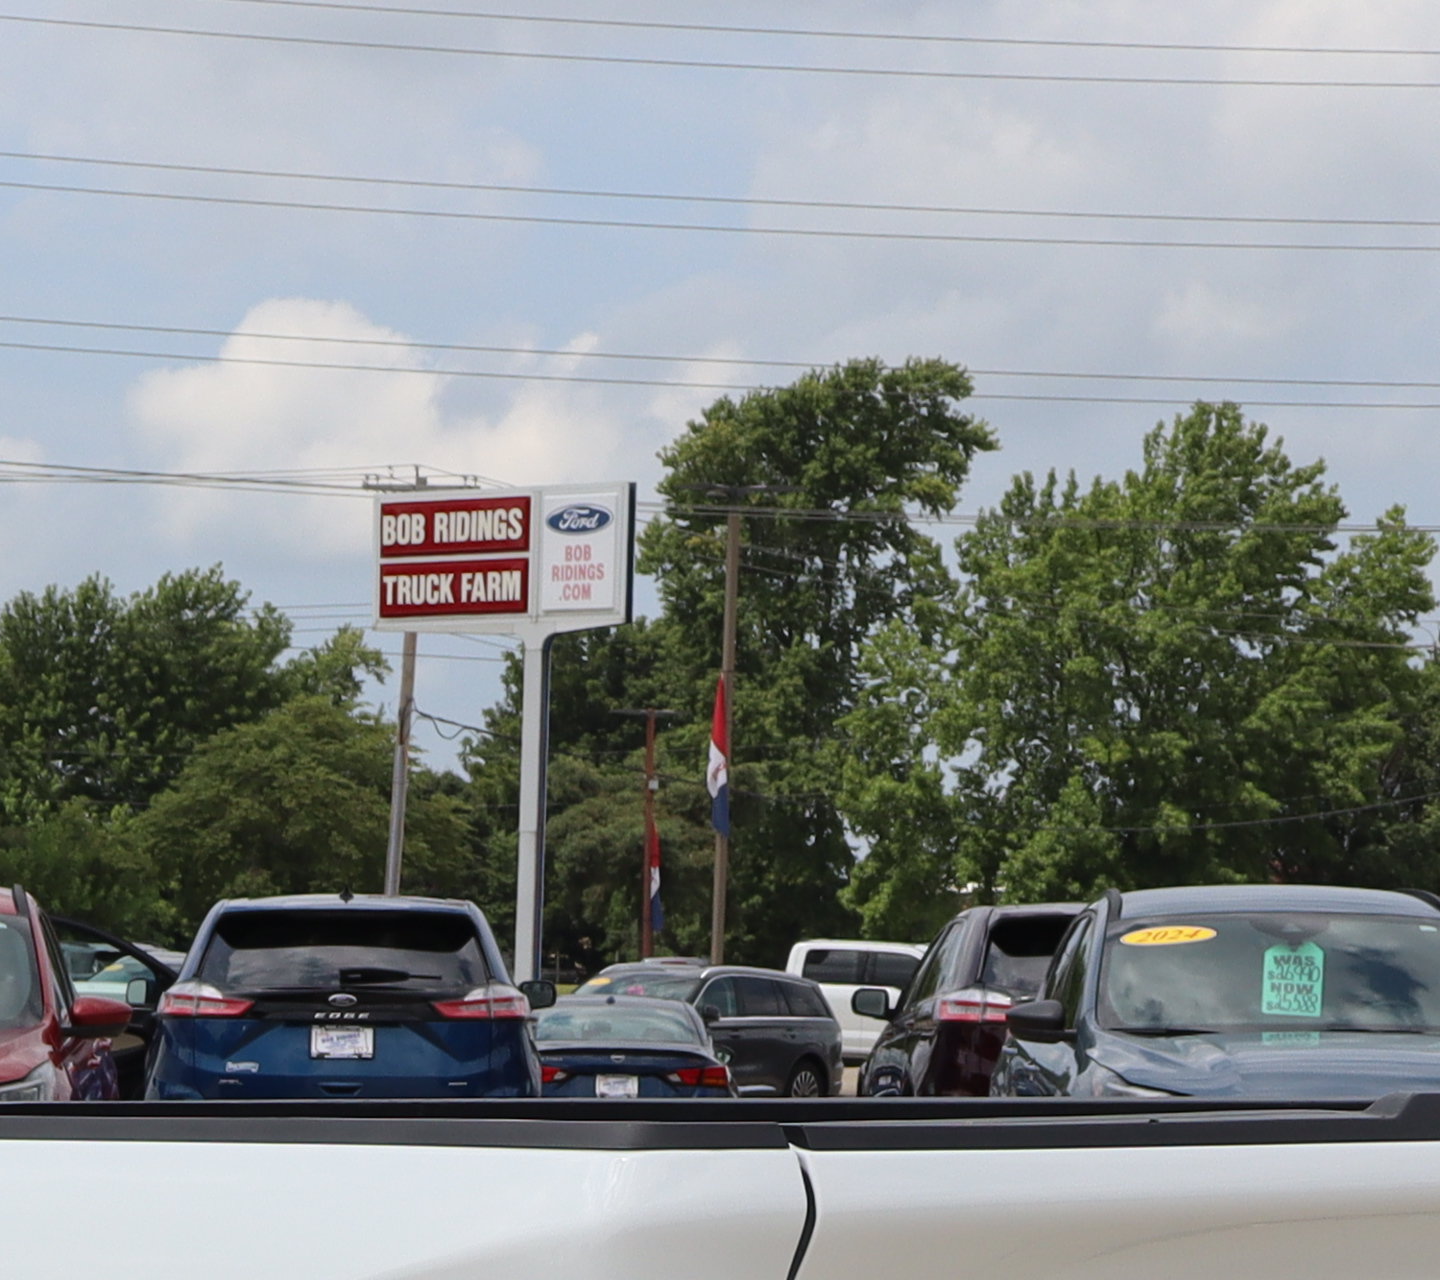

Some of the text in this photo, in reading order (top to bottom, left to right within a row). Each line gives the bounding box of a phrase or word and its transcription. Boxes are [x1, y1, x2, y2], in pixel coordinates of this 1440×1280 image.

[382, 508, 523, 546] BOB RIDINGS
[558, 506, 600, 530] Ford
[564, 544, 592, 562] BOB
[551, 563, 605, 581] RIDINGS
[383, 570, 522, 605] TRUCK FARM
[558, 583, 592, 601] .COM
[1136, 929, 1203, 942] 2024
[1273, 955, 1316, 967] WAS
[1270, 982, 1314, 995] NOW
